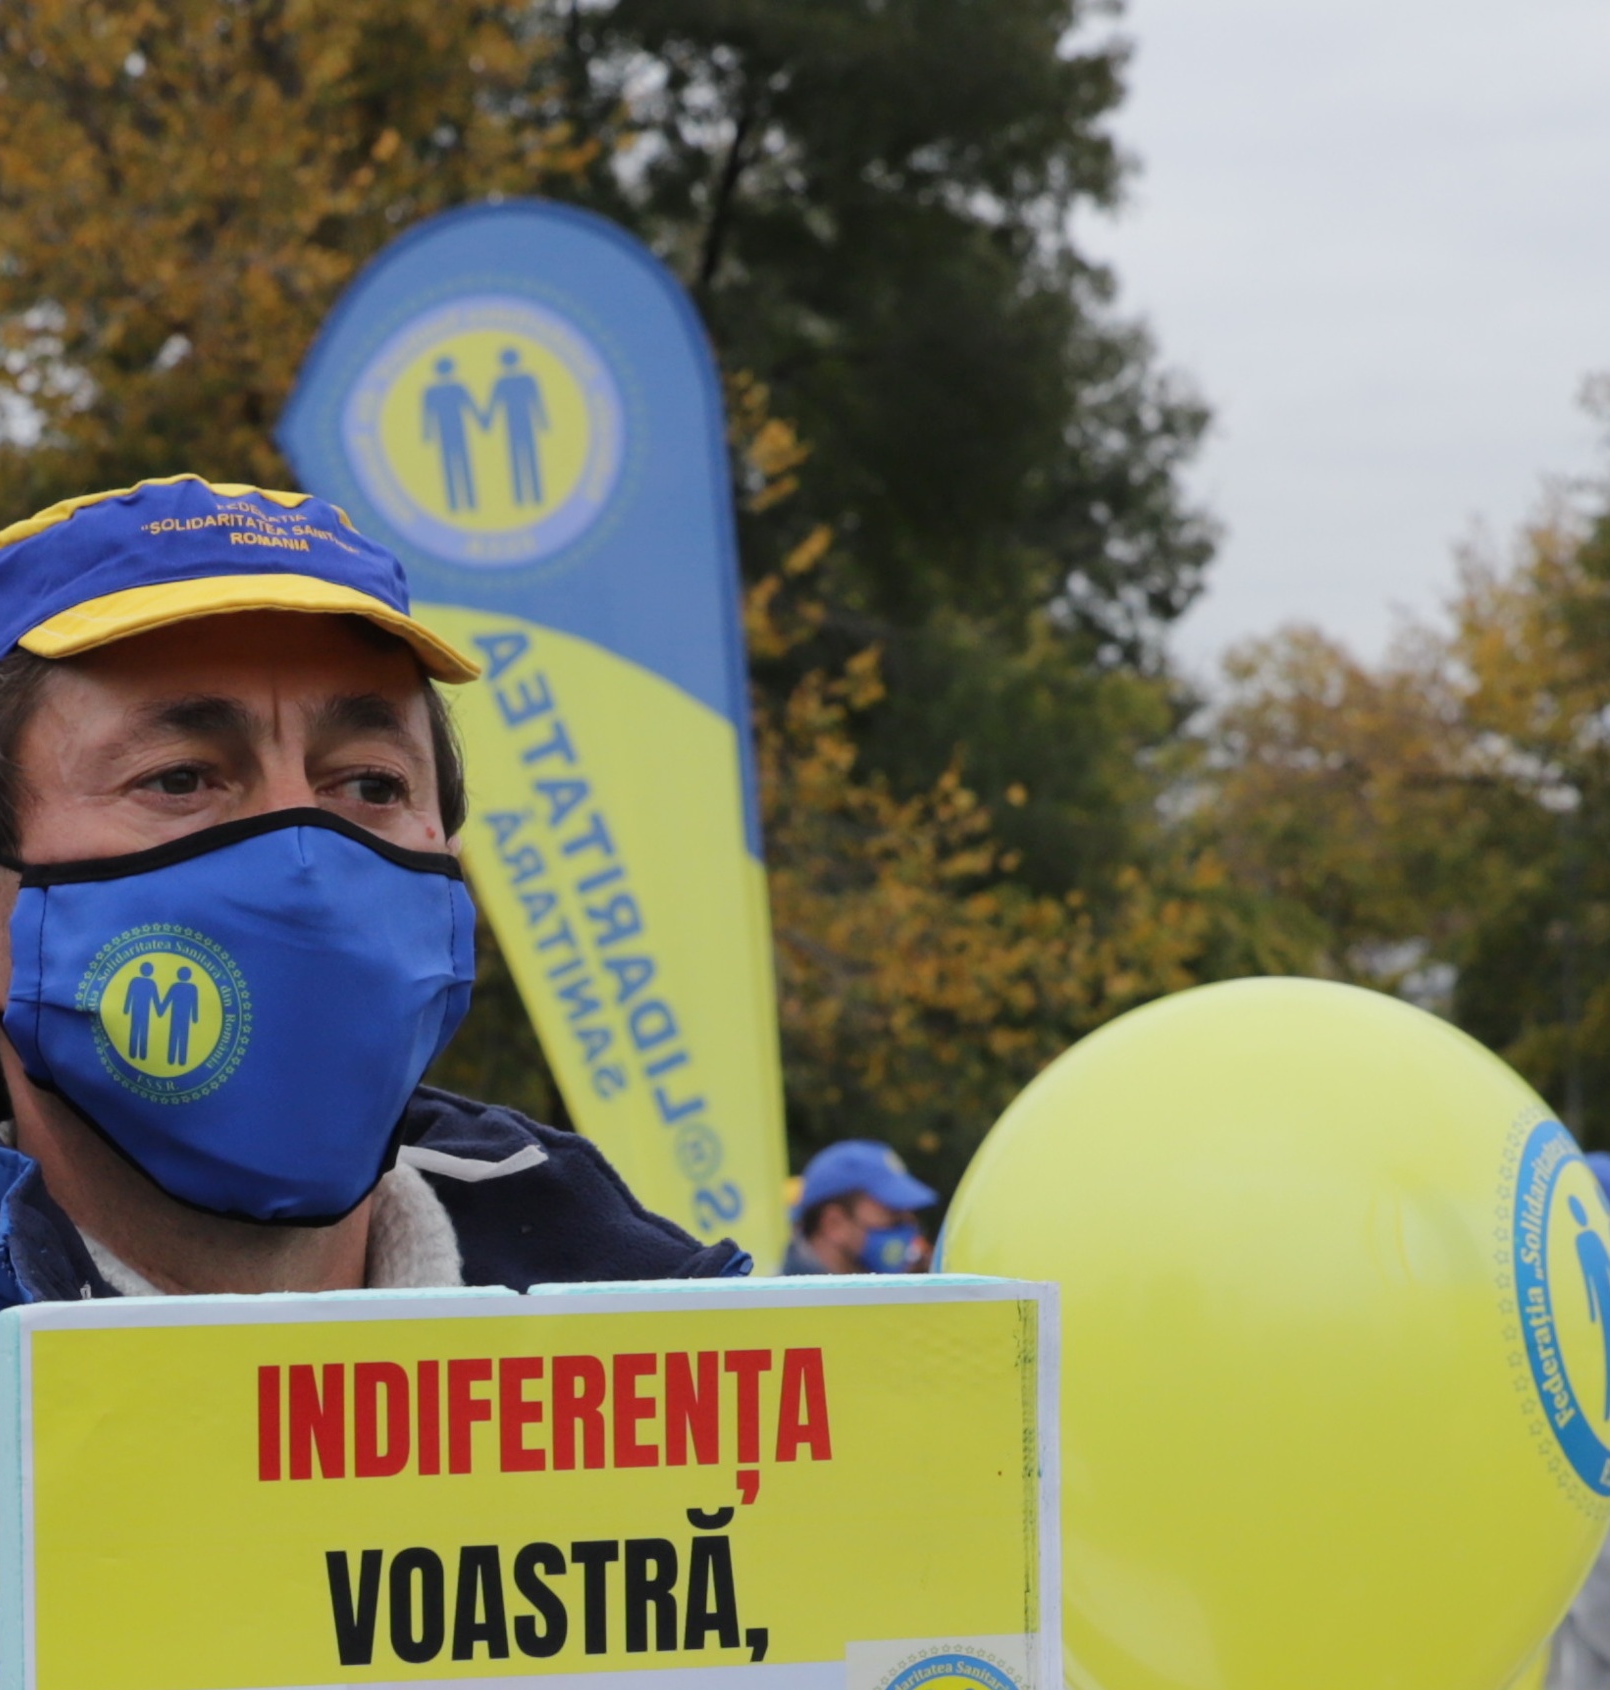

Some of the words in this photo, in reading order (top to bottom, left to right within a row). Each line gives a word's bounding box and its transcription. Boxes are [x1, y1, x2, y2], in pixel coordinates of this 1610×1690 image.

[229, 532, 310, 551] ROMANIA
[256, 1347, 833, 1506] INDIFERENȚA
[1525, 1286, 1576, 1430] Federația
[324, 1506, 769, 1667] VOASTRĂ,
